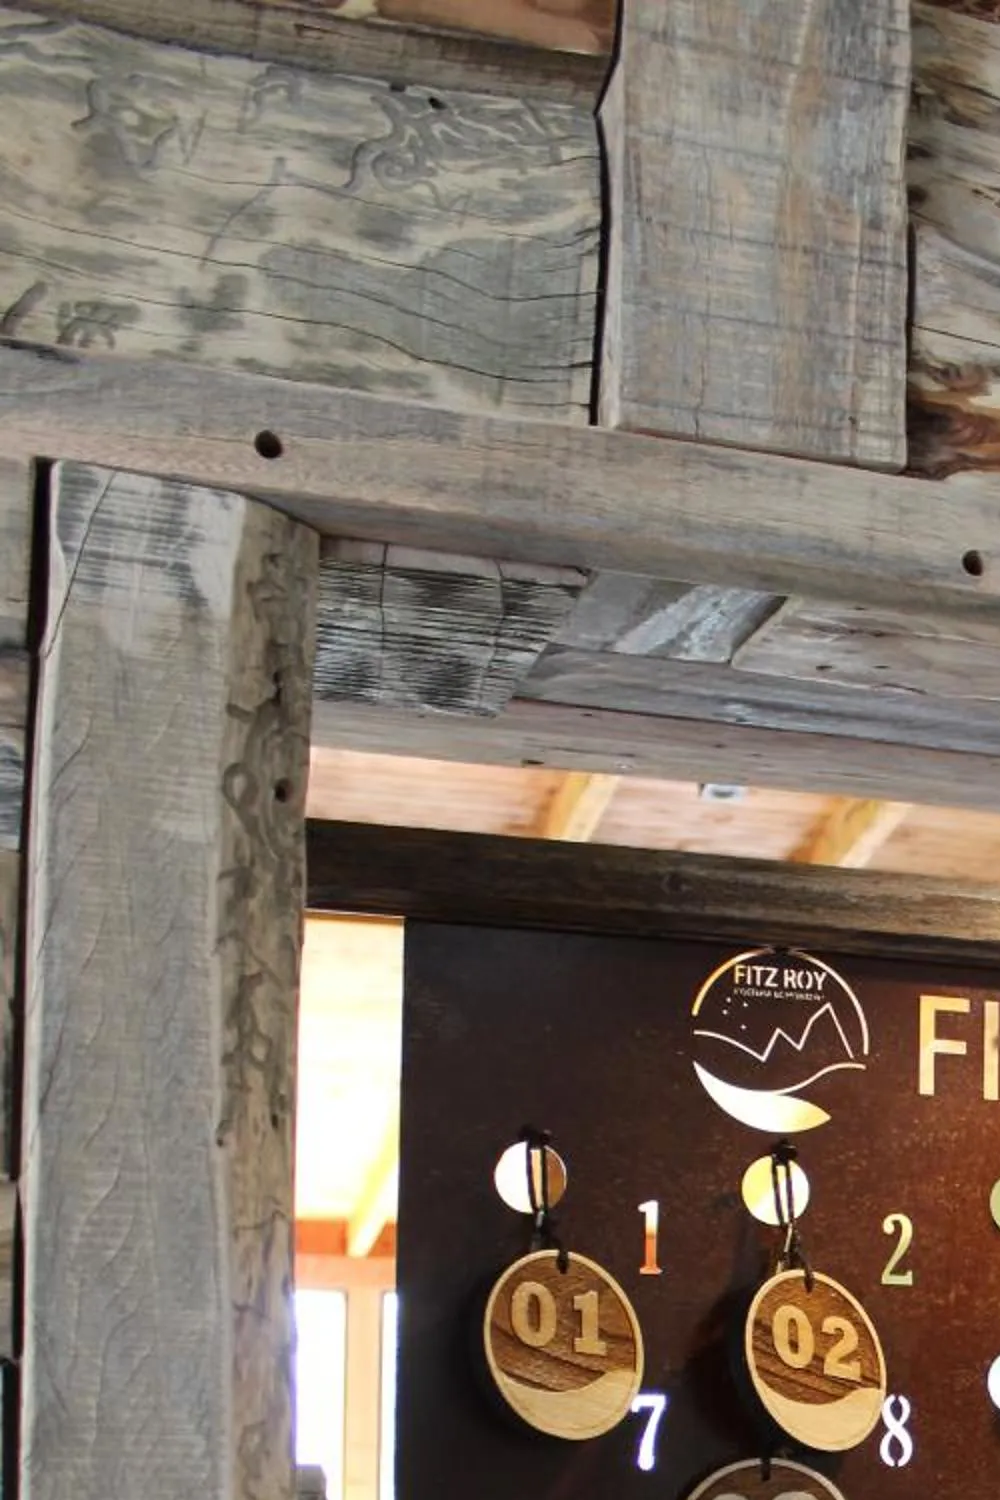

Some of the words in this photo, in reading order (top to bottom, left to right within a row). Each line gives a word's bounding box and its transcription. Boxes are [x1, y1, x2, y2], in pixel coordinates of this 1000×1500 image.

[735, 965, 779, 987] FITZ
[783, 968, 827, 991] ROY
[637, 1200, 663, 1276] 1
[881, 1213, 913, 1286] 2
[511, 1281, 607, 1357] 01
[772, 1304, 862, 1383] 02
[630, 1394, 667, 1471] 7
[880, 1395, 913, 1467] 8
